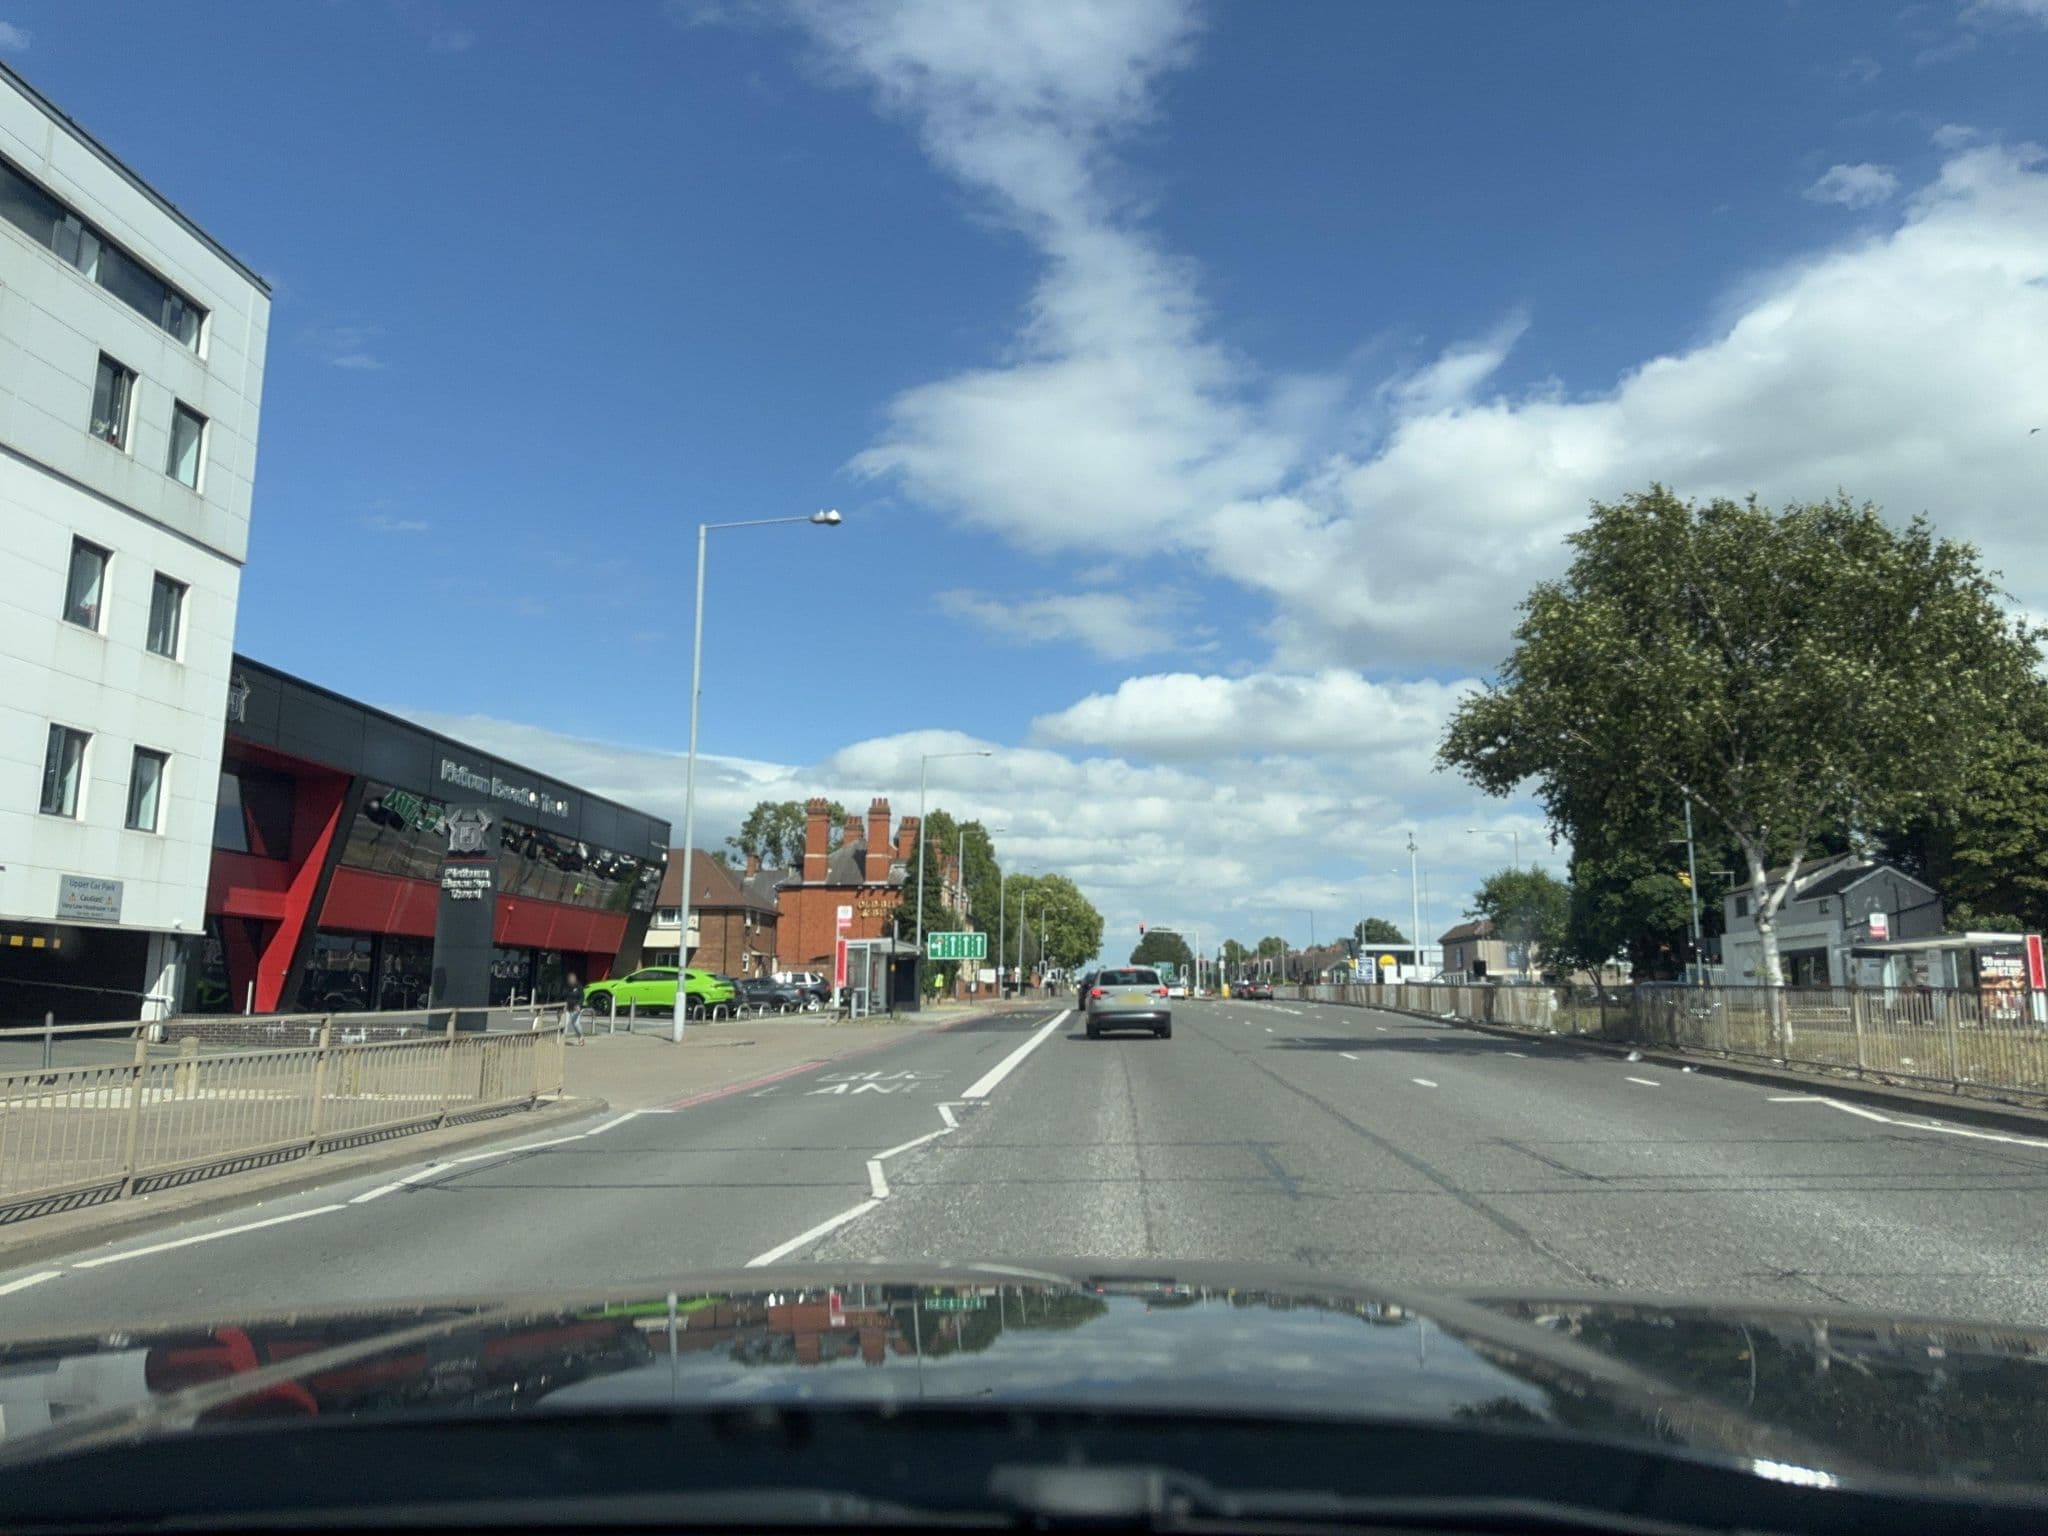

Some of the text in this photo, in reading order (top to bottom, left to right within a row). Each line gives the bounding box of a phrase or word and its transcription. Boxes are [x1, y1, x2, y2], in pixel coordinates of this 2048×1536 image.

[441, 759, 490, 793] Platinum
[444, 867, 490, 878] Platinum
[69, 879, 89, 889] Upper
